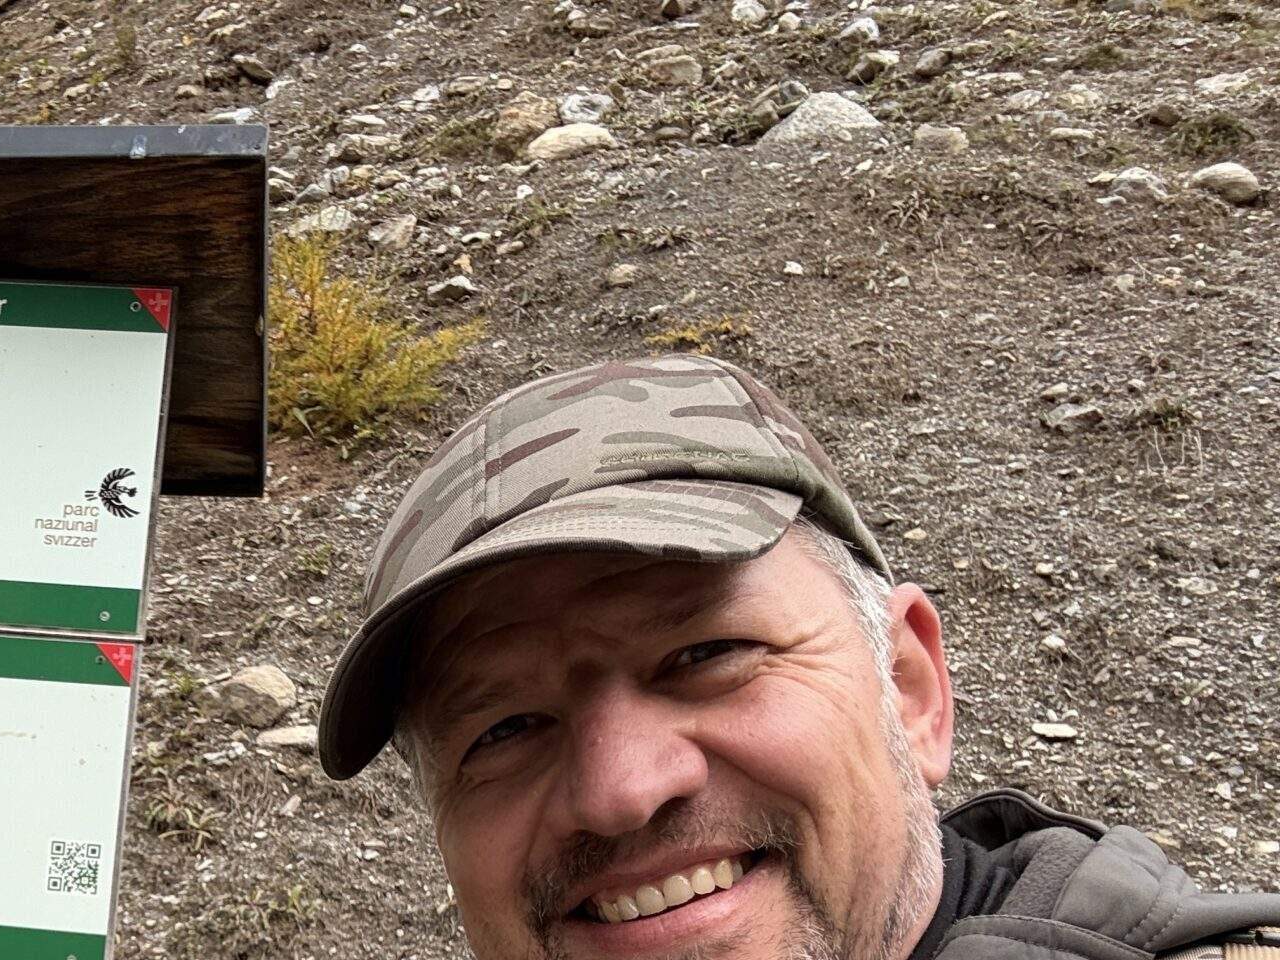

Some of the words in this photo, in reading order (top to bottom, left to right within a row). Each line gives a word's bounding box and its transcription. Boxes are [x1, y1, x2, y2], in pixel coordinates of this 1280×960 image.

[63, 503, 100, 518] parc
[34, 517, 98, 533] naziunal
[43, 534, 97, 548] svizzer
